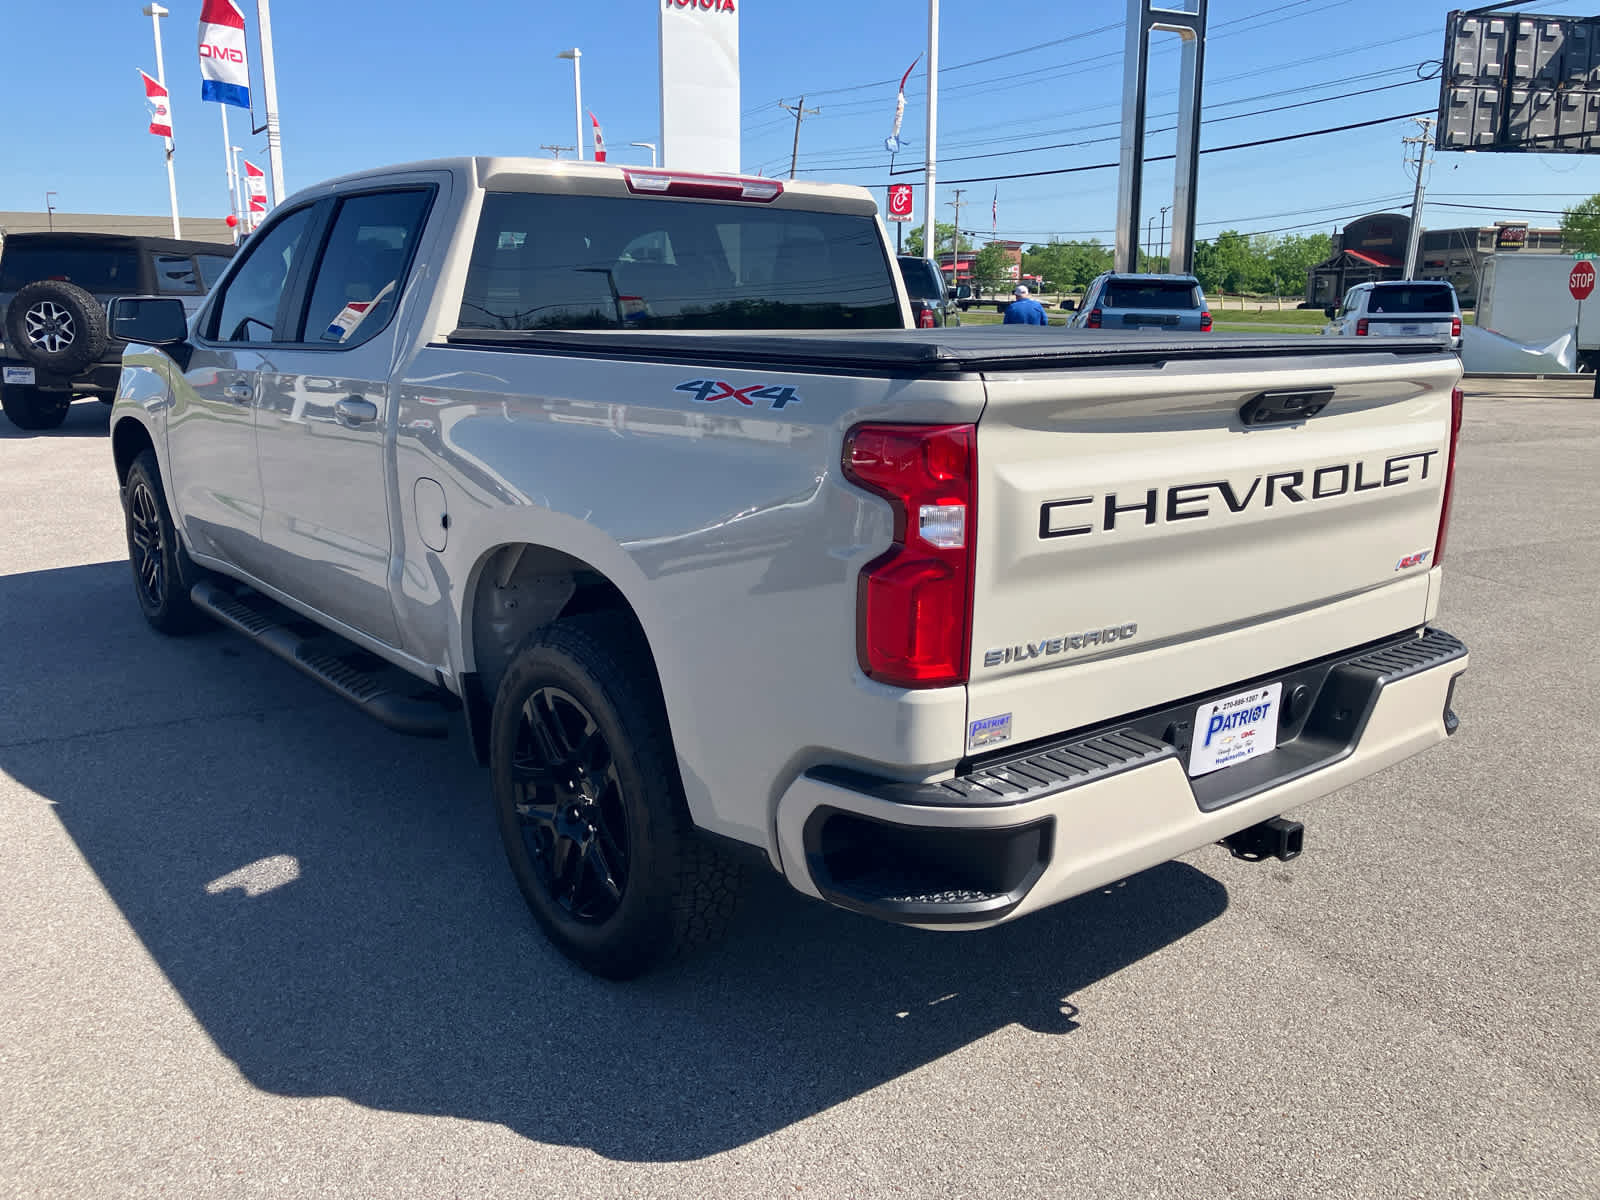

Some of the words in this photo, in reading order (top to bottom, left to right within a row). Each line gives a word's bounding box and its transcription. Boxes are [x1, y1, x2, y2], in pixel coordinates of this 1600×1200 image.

[1570, 273, 1594, 288] STOP
[1039, 450, 1438, 539] CHEVROLET
[983, 623, 1138, 667] SILVERADO
[972, 715, 1012, 737] PATRIOT
[1204, 703, 1271, 747] PATRIOT
